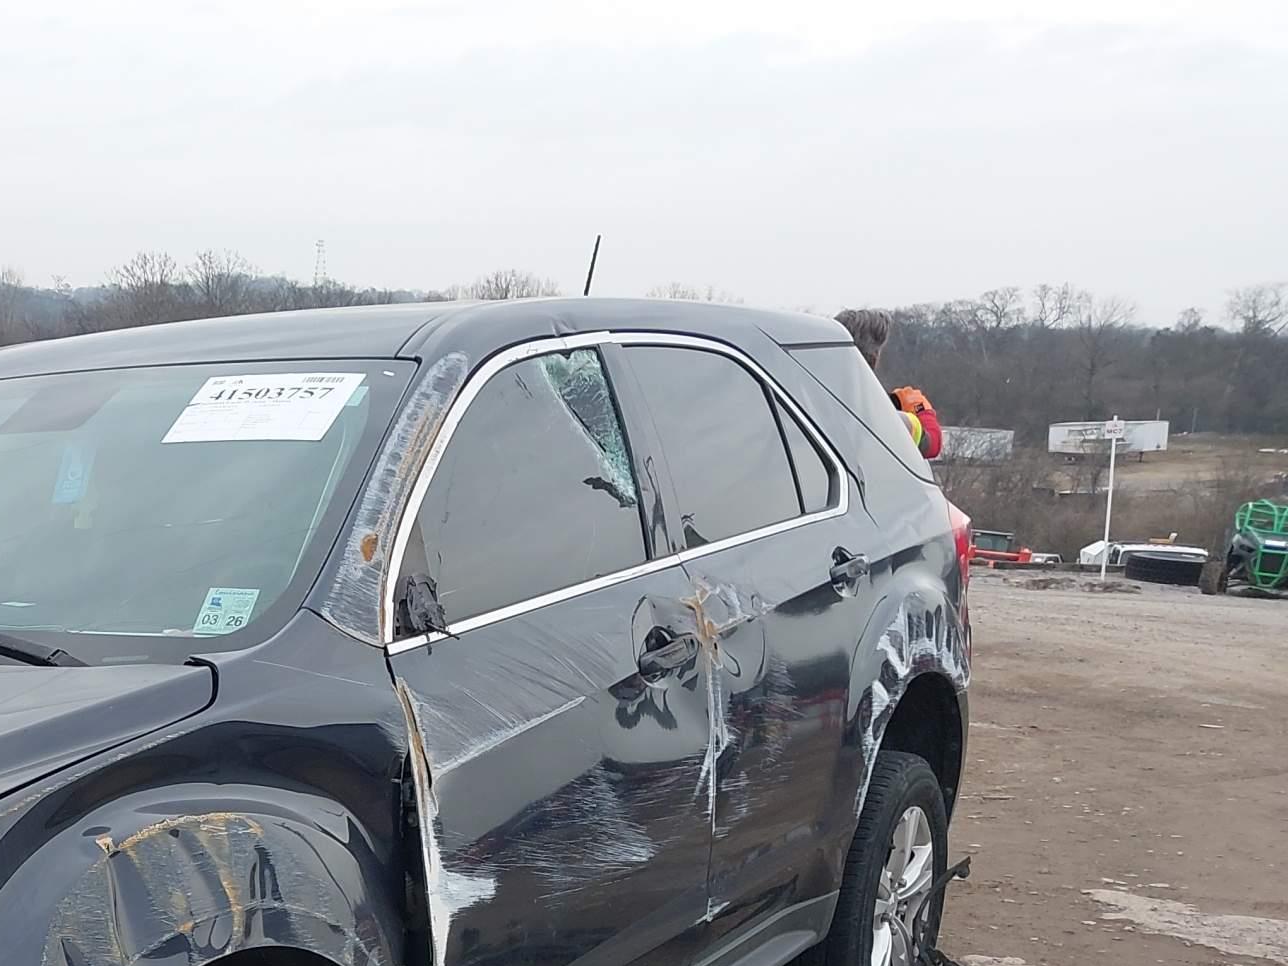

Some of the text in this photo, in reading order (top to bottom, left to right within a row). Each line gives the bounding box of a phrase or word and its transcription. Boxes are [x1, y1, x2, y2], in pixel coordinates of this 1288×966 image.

[209, 387, 335, 401] 41503757
[202, 614, 244, 627] 03 26
